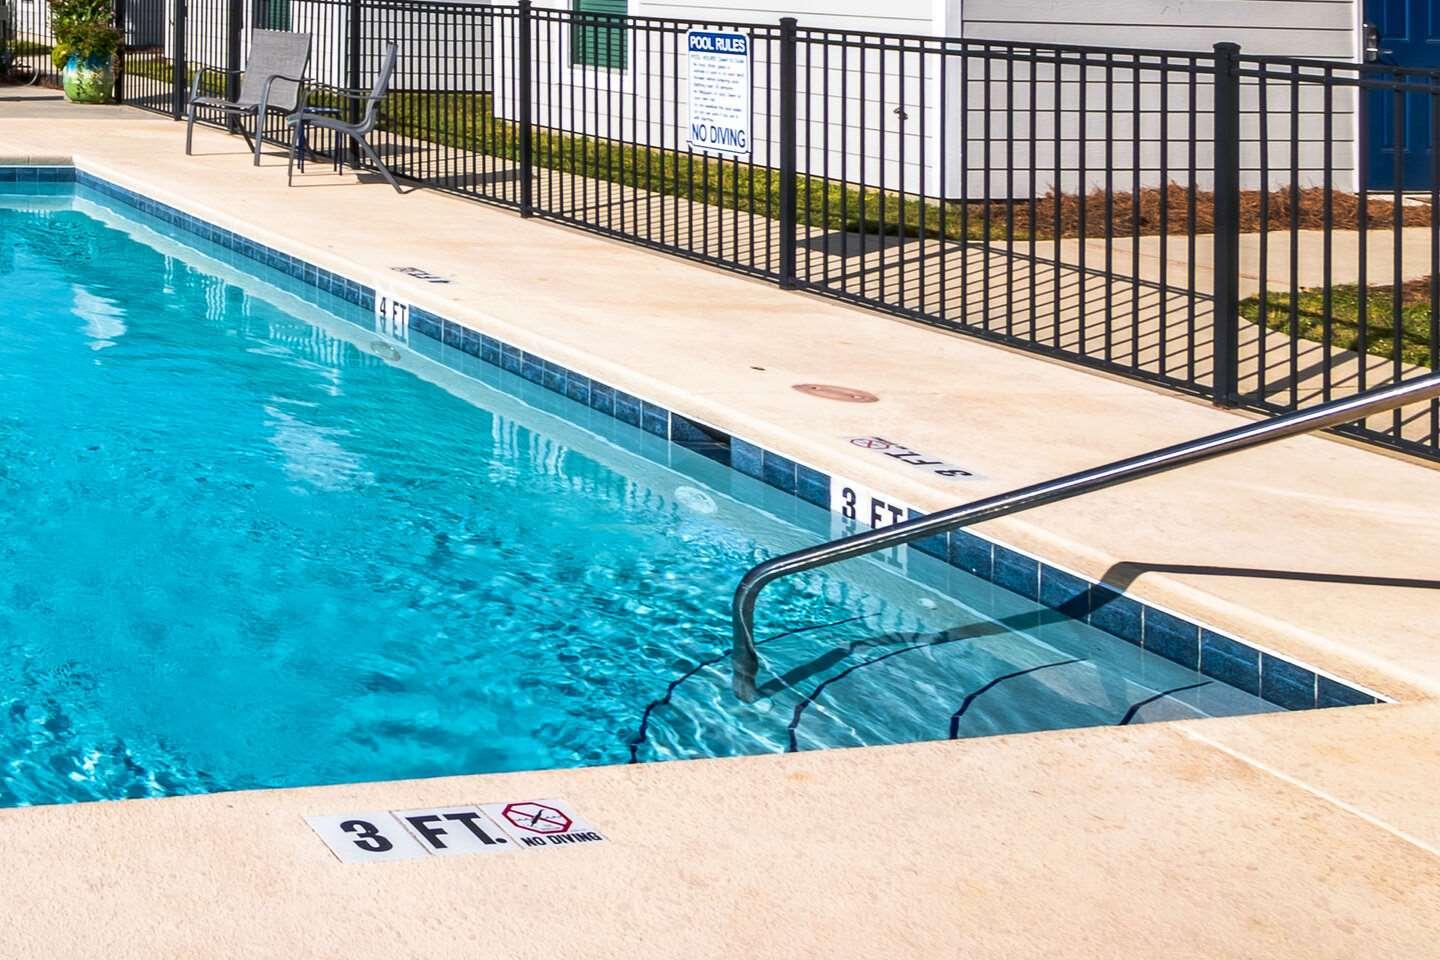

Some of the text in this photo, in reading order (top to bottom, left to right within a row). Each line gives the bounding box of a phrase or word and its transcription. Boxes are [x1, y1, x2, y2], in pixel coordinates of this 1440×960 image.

[690, 36, 745, 52] POOL RULES
[692, 123, 746, 148] NO DIVING
[380, 297, 407, 325] 4 FT
[842, 487, 903, 529] 3 FT
[339, 812, 508, 852] 3 FT.
[520, 831, 603, 847] NO DIVING
